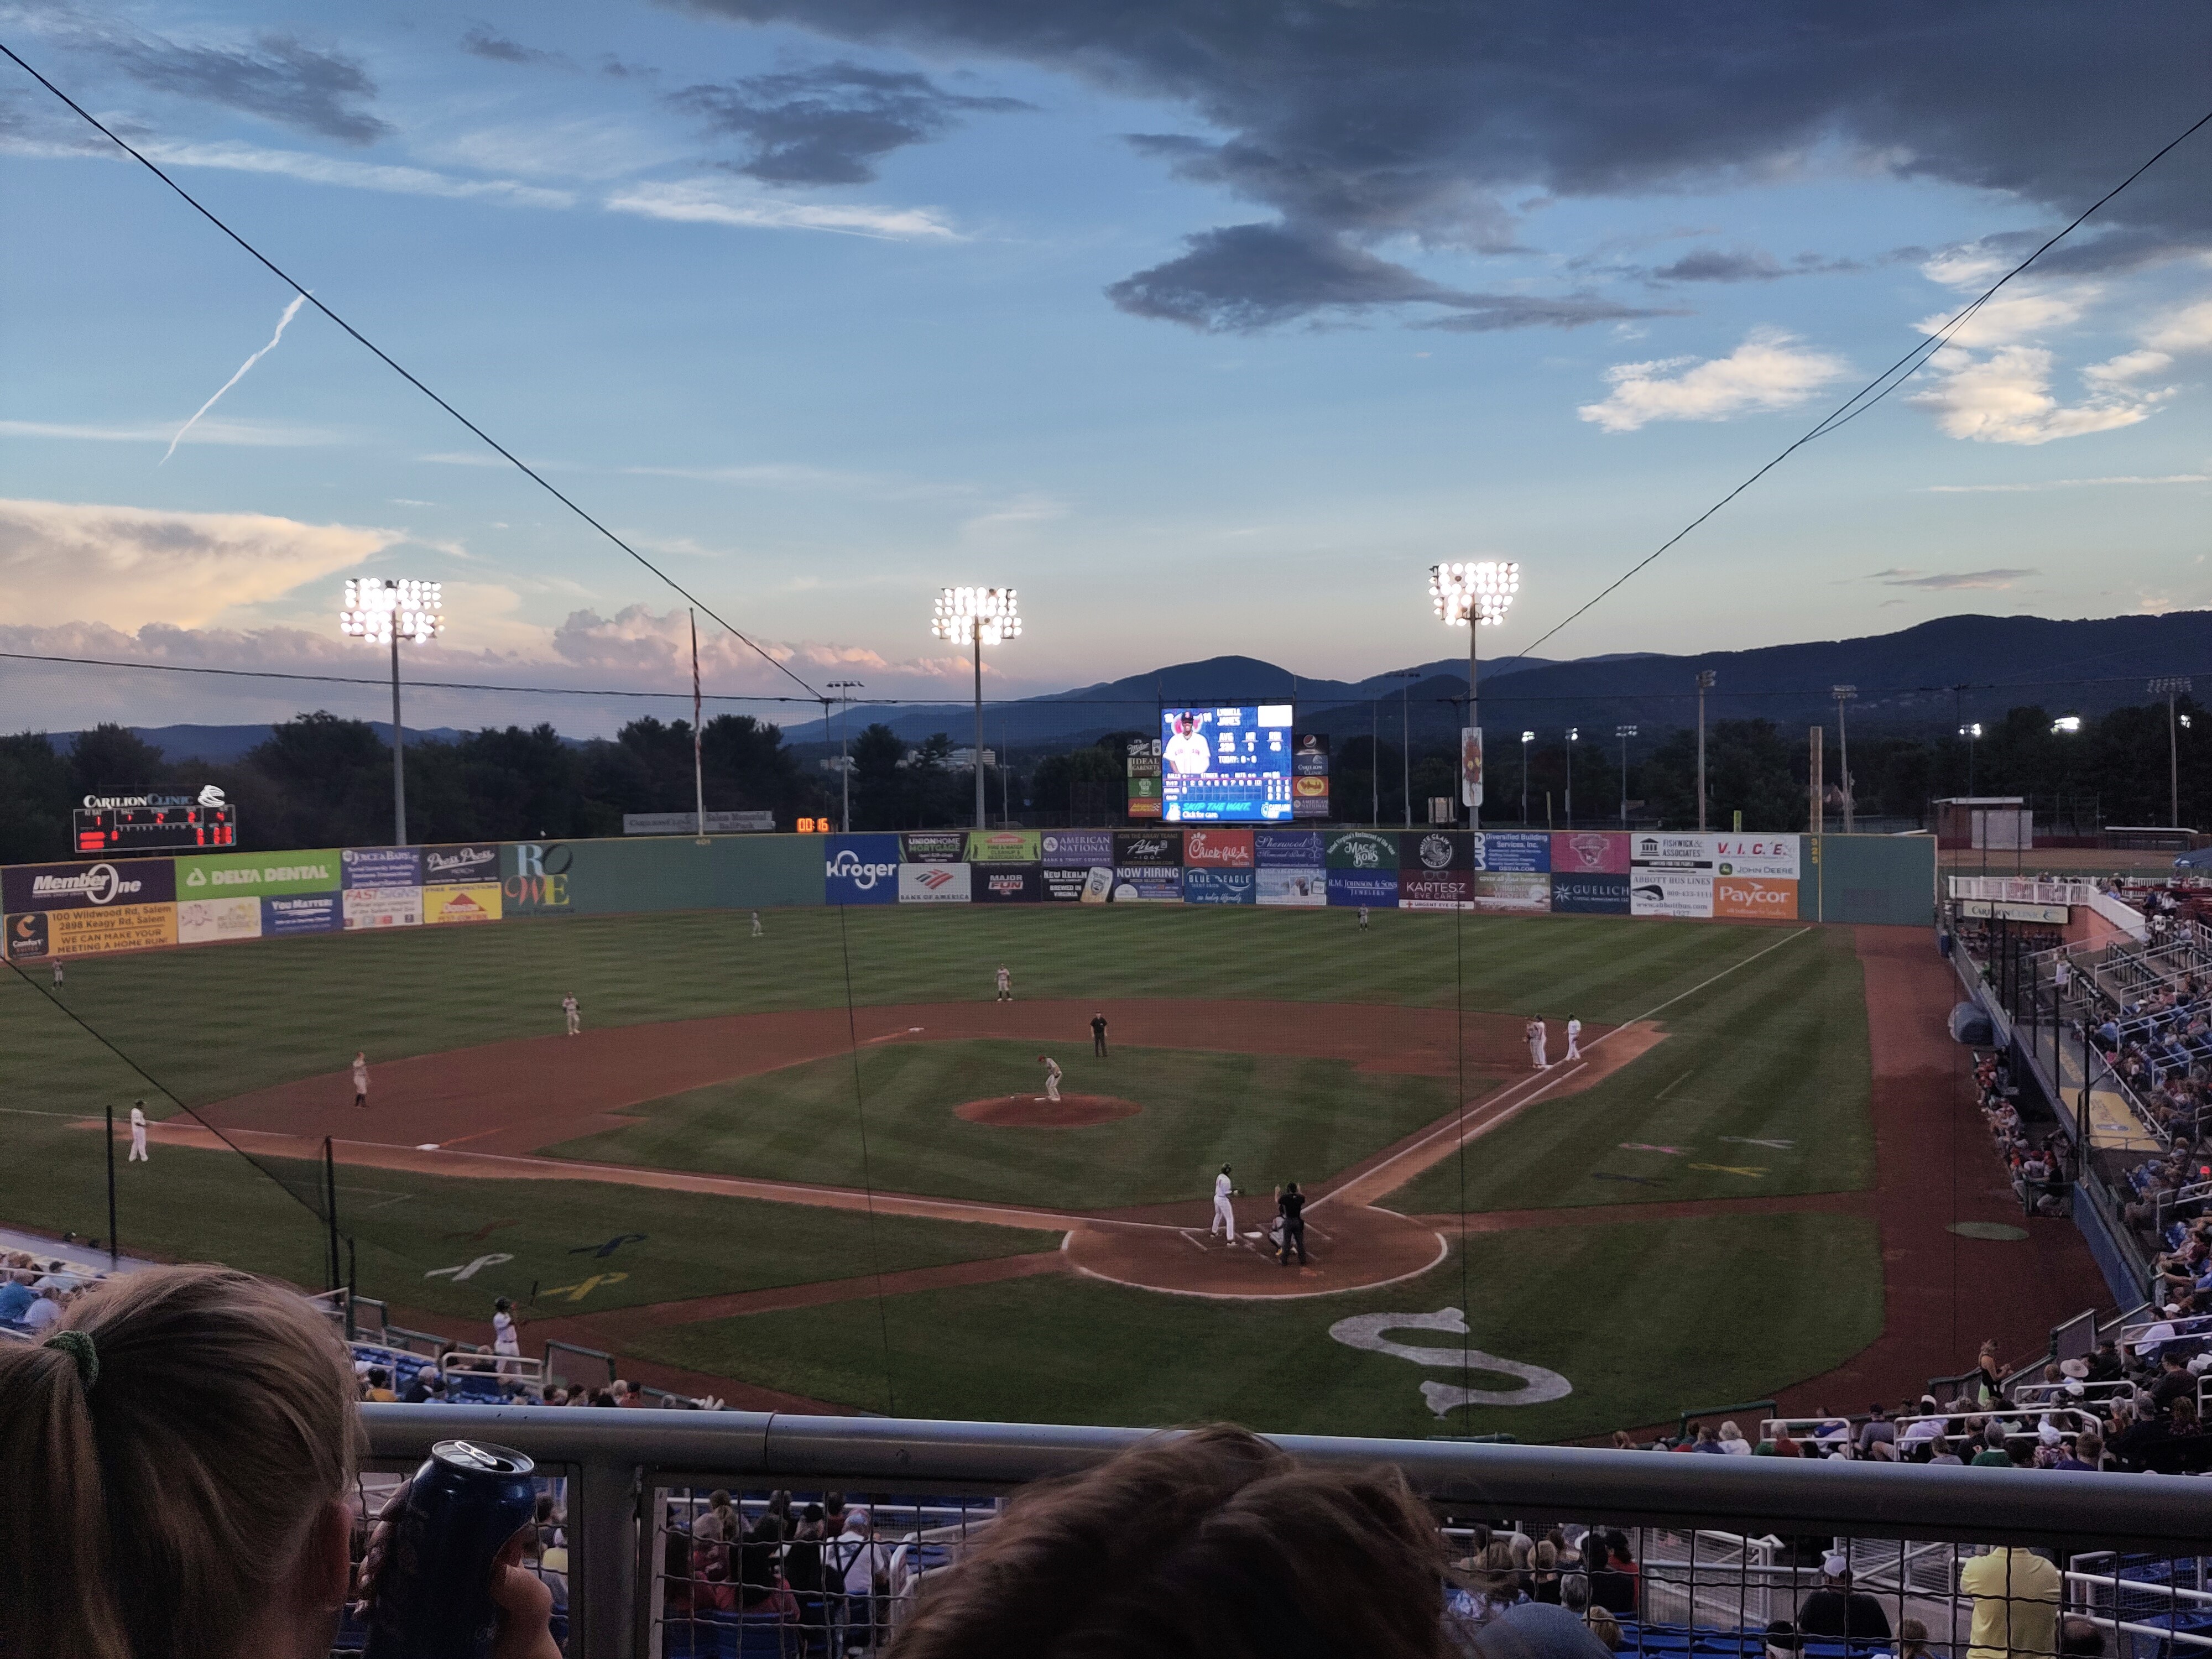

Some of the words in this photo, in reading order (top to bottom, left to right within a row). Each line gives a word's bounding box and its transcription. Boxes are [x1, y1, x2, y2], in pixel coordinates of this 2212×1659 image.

[83, 795, 147, 809] CARILION
[1183, 802, 1205, 811] SKIP
[1207, 802, 1225, 811] THE
[797, 817, 829, 832] 00:16
[1255, 836, 1308, 847] Sherwood
[1521, 833, 1547, 842] Building
[1663, 839, 1693, 848] FISHWICK
[1127, 839, 1165, 855] Arkay
[1189, 836, 1249, 862] Chick-fil-A
[1344, 842, 1369, 854] MAC
[1420, 835, 1431, 856] WHITE
[1431, 833, 1450, 845] CLAW
[1718, 842, 1730, 854] V.
[1752, 843, 1766, 854] C.
[1662, 849, 1700, 857] ASSOCIATES
[211, 869, 262, 885] DELTA
[264, 864, 330, 883] DENTAL
[826, 850, 896, 889] Kroger
[1117, 868, 1141, 878] NOW
[1143, 868, 1179, 878] HIRING
[1764, 866, 1793, 874] DEERE
[33, 873, 110, 892] Member
[86, 863, 142, 905] One
[1188, 874, 1211, 883] BLUE
[1223, 875, 1250, 883] EAGLE
[1344, 879, 1373, 889] JOHNSON
[1381, 880, 1397, 888] SONS
[1633, 876, 1666, 884] ABBOTT
[1406, 881, 1466, 893] KARTESZ
[1573, 885, 1630, 895] GUELICH
[1719, 886, 1791, 907] Paycor
[53, 912, 70, 921] 100
[74, 908, 122, 920] Wildwood
[143, 906, 171, 915] Salem
[1971, 905, 2010, 917] CARIION
[86, 919, 115, 930] Keagy
[137, 915, 165, 924] Salem
[82, 934, 101, 942] CAN
[105, 931, 132, 940] MAKE
[135, 929, 161, 937] YOUR
[58, 942, 101, 953] MEETING
[114, 939, 142, 947] HOME
